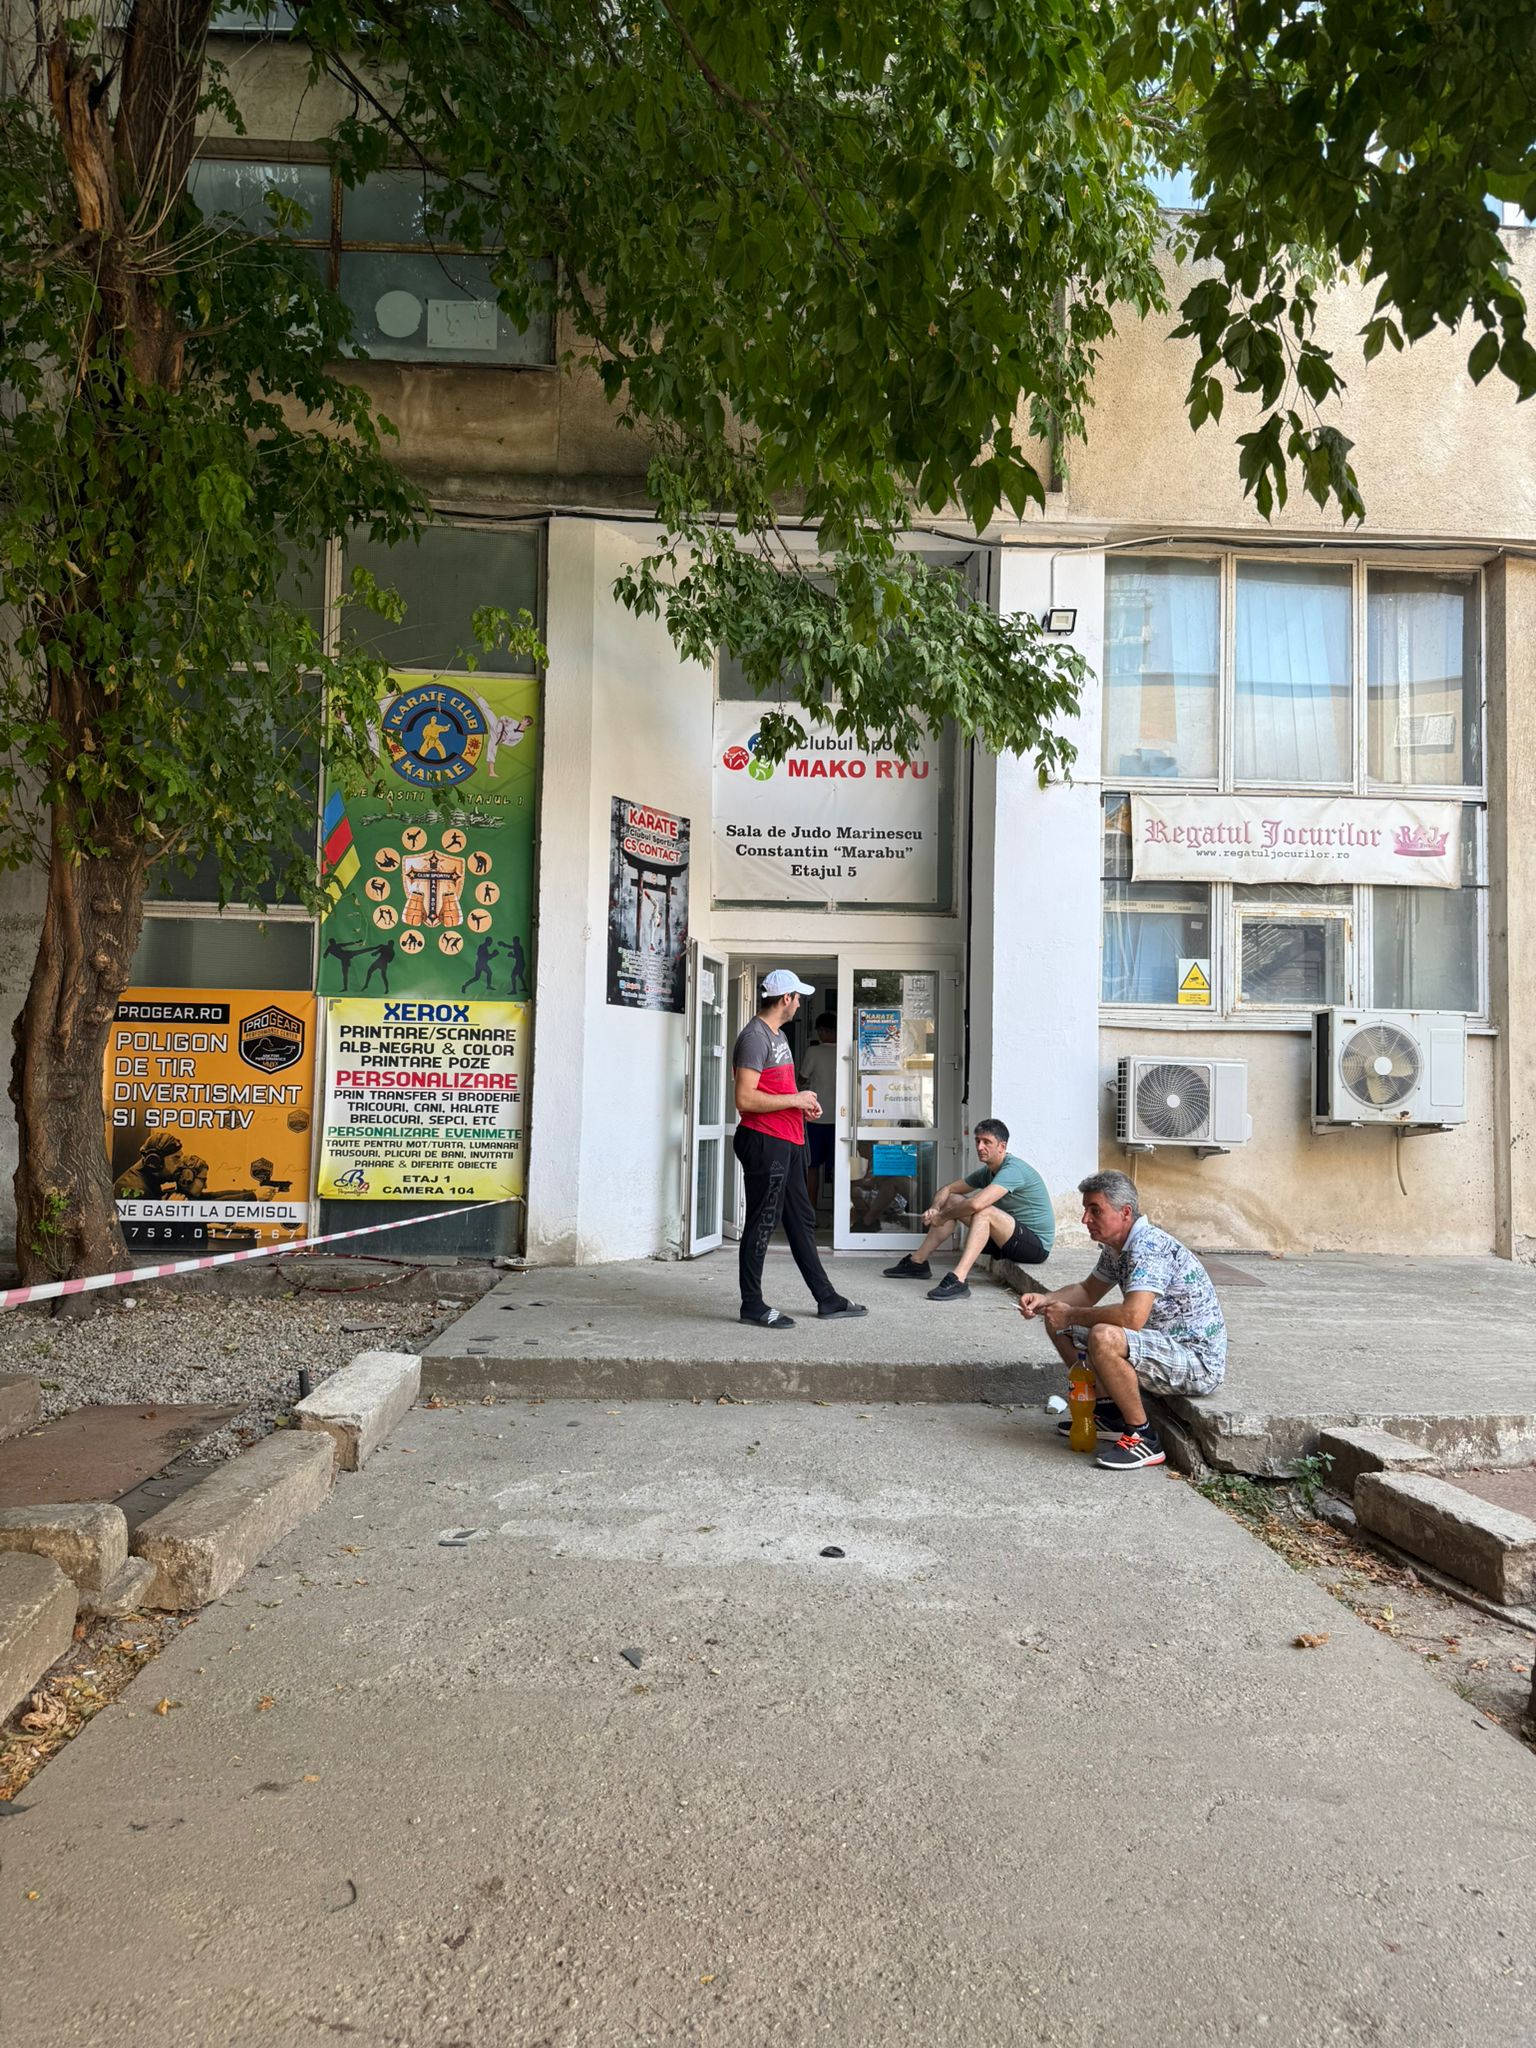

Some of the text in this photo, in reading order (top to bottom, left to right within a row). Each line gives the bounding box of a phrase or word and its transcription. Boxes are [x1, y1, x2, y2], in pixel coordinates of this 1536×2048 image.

[391, 691, 478, 729] KARATE CLUB
[788, 759, 929, 780] MAKO RYU
[629, 808, 678, 838] KARATE
[630, 829, 651, 841] Clubul
[726, 825, 923, 840] Sala de Judo Marinescu
[1144, 819, 1383, 849] Regatul Jocurilor
[625, 839, 680, 863] CS CONTACT
[735, 844, 829, 858] Constantin
[1196, 849, 1351, 860] www.regatuljocurilor.ro
[791, 864, 857, 880] Etajul 5
[118, 1005, 222, 1021] PROGEAR.RO
[383, 1003, 470, 1023] XEROX
[246, 1012, 298, 1032] PROGEAR
[340, 1025, 517, 1042] PRINTARE/SCANARE
[117, 1031, 229, 1053] POLIGON
[340, 1041, 515, 1057] ALB-NEGRU & COLOR
[114, 1057, 197, 1078] DE TIR
[361, 1055, 491, 1070] PRINTARE POZE
[335, 1070, 519, 1090] PERSONALIZARE
[113, 1082, 303, 1105] DIVERTISMENT
[334, 1090, 521, 1103] PRIN TRANSFER SI BRODERIE
[450, 1104, 500, 1114] HALATE
[111, 1108, 256, 1130] SI SPORTIV
[472, 1116, 497, 1126] ETC
[328, 1126, 522, 1139] PERSONALIZARE EVENIMETE
[326, 1139, 360, 1148] TAVITE
[364, 1140, 402, 1149] PENTRU
[469, 1142, 519, 1150] LUMANARI
[384, 1150, 421, 1158] PLICURI
[424, 1151, 438, 1159] DE
[470, 1152, 514, 1160] INVITATII
[354, 1160, 498, 1170] PAHARE & DIFERITE OBIECTE
[402, 1175, 451, 1184] ETAJ 1
[382, 1186, 475, 1195] CAMERA 104
[117, 1204, 298, 1219] NE GASITI LA DEMISOL
